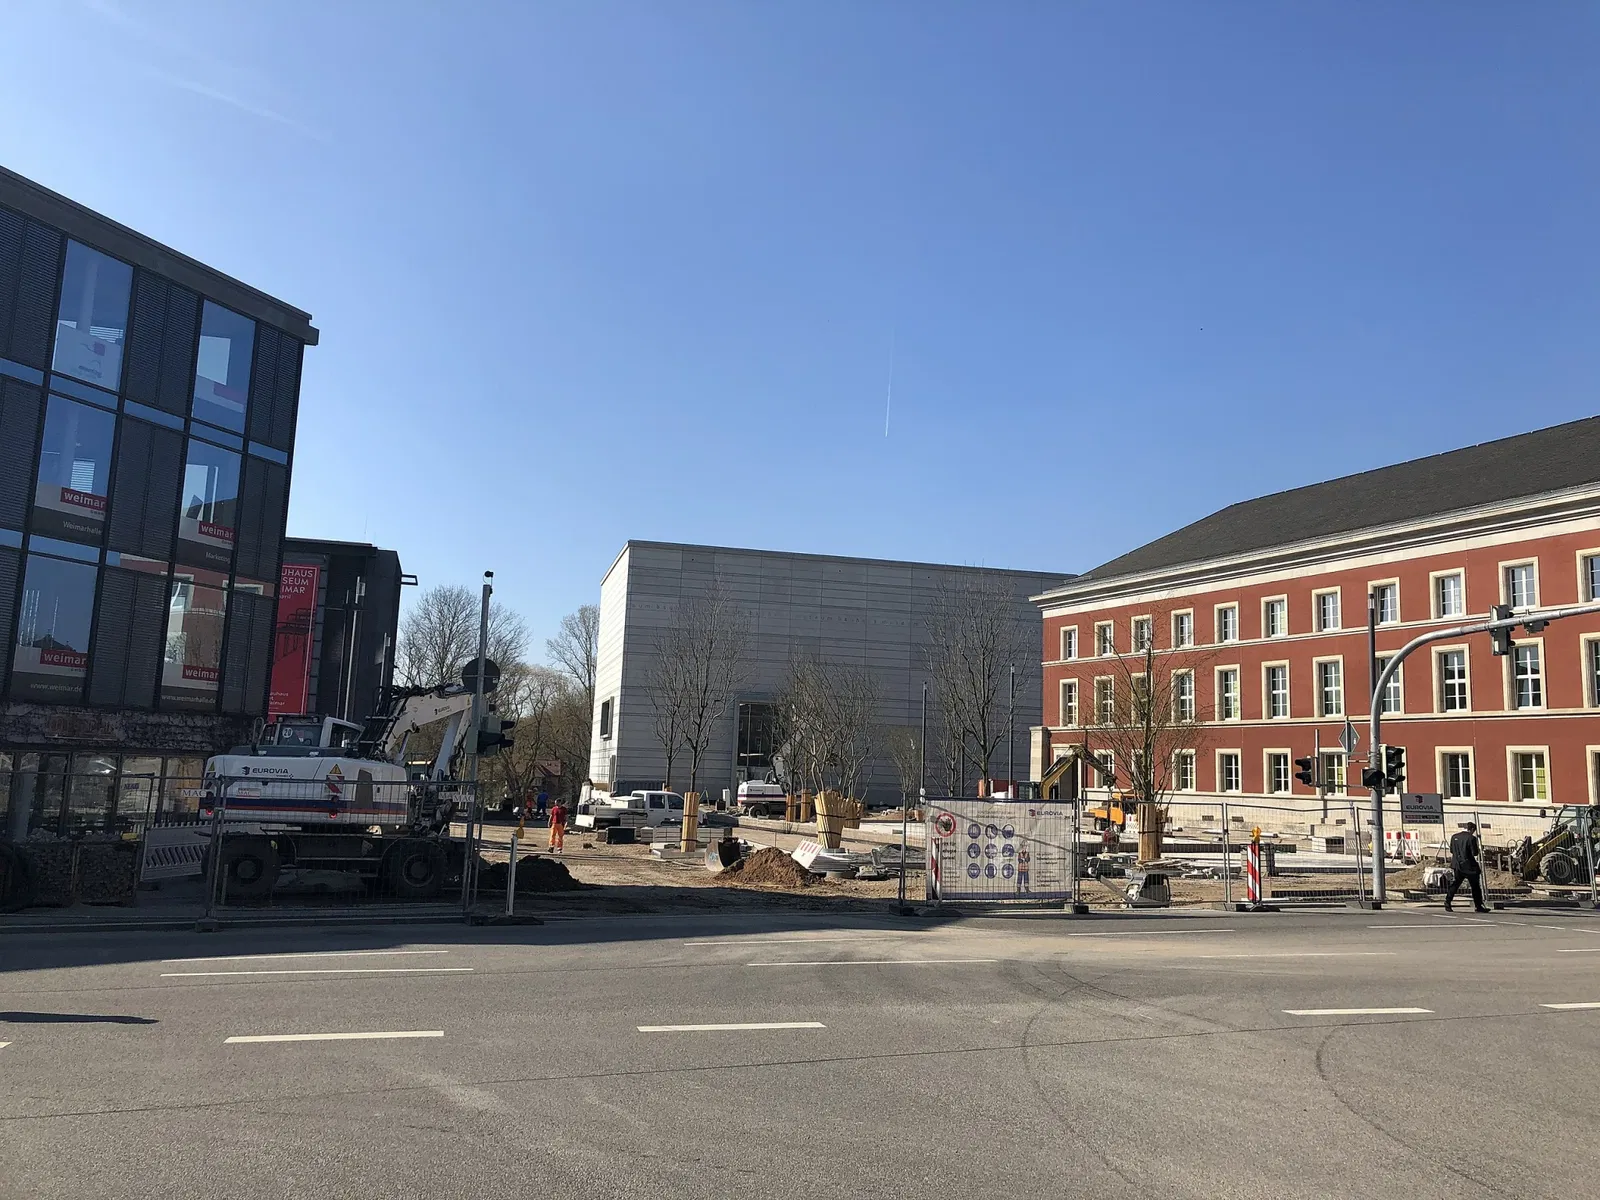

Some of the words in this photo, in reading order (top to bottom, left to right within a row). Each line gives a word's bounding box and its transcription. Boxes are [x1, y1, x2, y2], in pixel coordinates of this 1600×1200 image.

[64, 492, 106, 508] weimar
[201, 525, 234, 538] weimar
[44, 653, 87, 665] weimar
[185, 668, 219, 679] weimar
